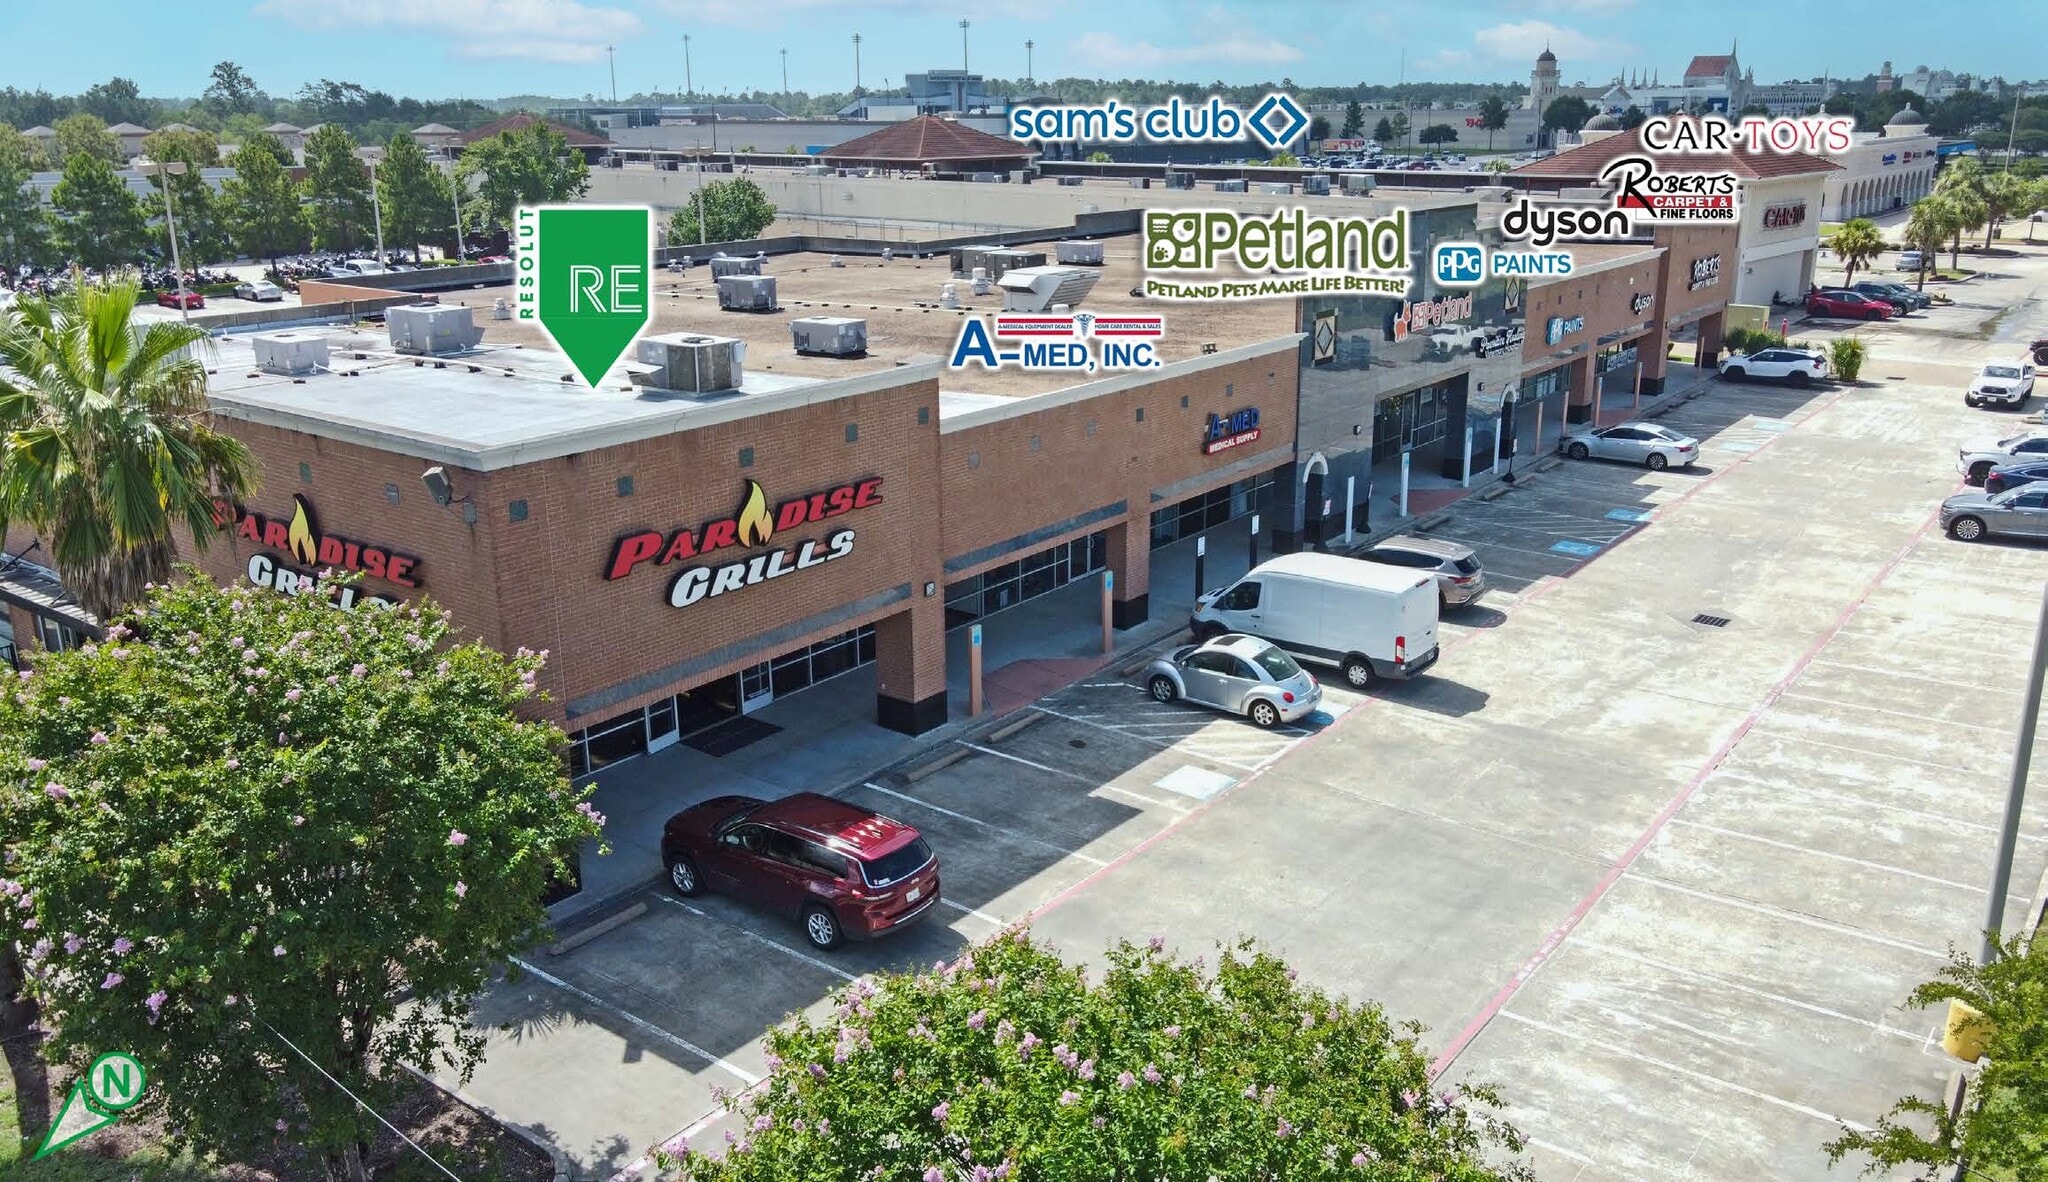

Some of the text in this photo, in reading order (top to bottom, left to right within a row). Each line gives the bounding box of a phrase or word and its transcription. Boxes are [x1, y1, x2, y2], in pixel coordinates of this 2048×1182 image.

[1424, 291, 1473, 326] Petland
[1633, 292, 1655, 316] dyson
[1564, 316, 1585, 336] PAINTS
[1209, 430, 1259, 454] MEDICAL SUPPLY
[669, 529, 857, 608] GRILLS
